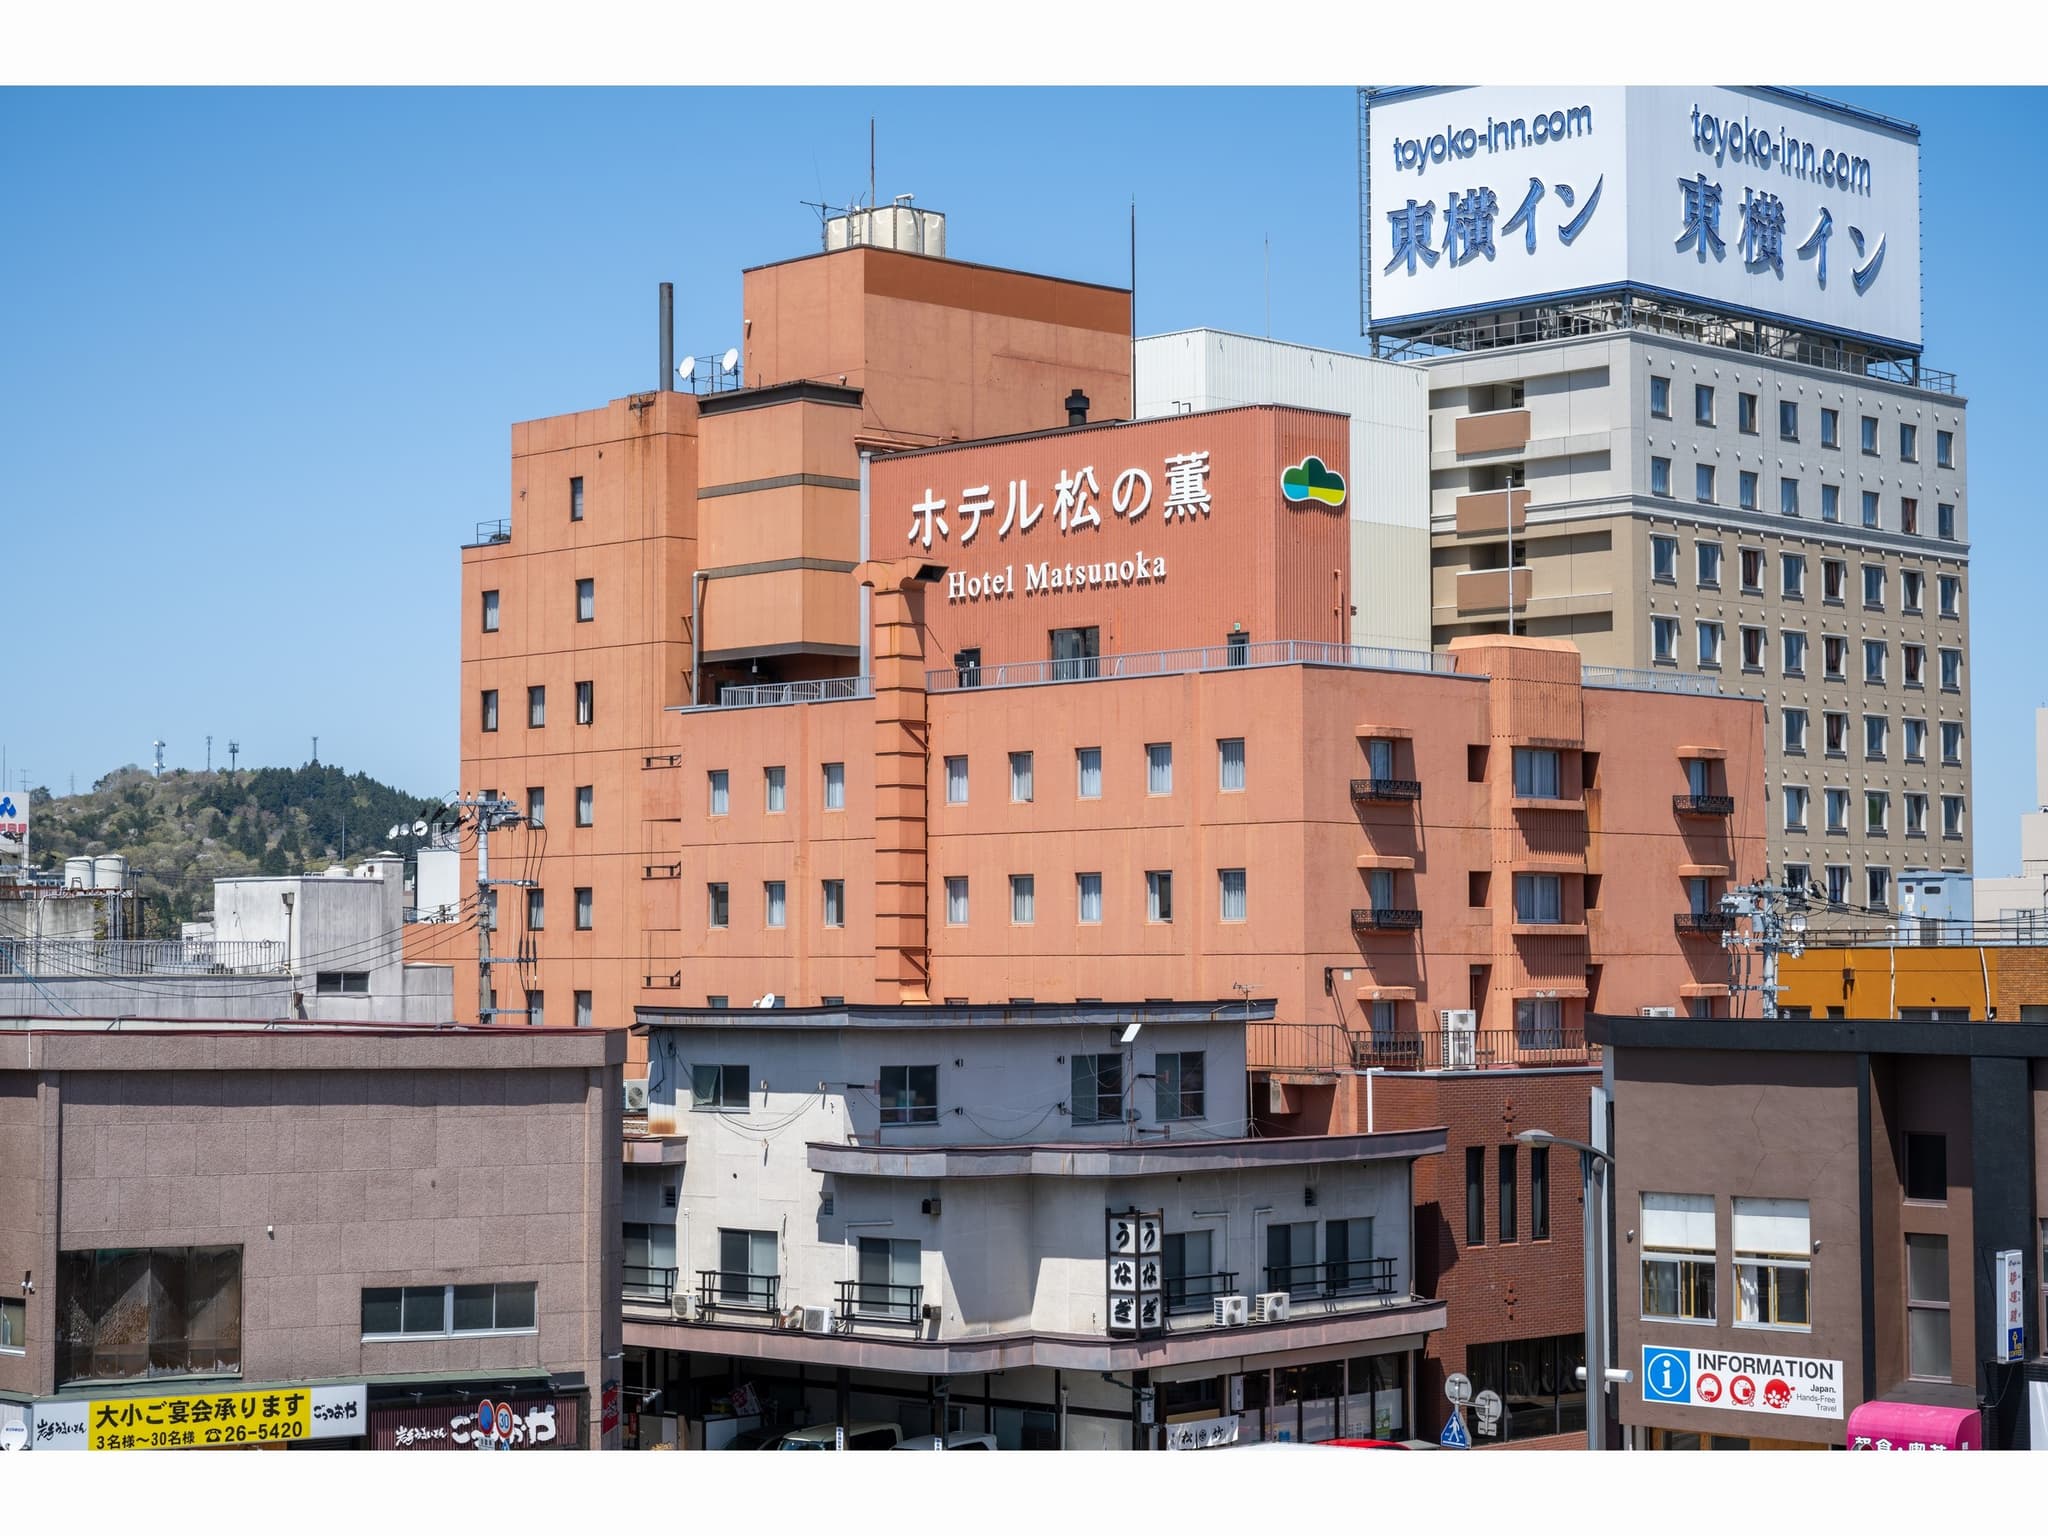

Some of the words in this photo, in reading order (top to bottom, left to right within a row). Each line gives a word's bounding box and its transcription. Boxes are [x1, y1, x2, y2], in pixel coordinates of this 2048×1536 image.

[1393, 105, 1592, 175] toyoko-inn.com
[1690, 103, 1871, 194] toyoko-inn.com
[1384, 173, 1603, 276] 東横イン
[1675, 173, 1886, 291] 東横イン
[908, 450, 1212, 549] ホテル松の薫
[948, 565, 1014, 599] Hotel
[1025, 551, 1167, 592] Matsunoka
[1696, 1353, 1833, 1380] INFORMATION
[1796, 1393, 1836, 1404] Hands-Free
[1810, 1384, 1836, 1394] Japan.
[96, 1393, 304, 1428] 大小ご宴会承ります
[499, 1413, 509, 1429] 30
[1816, 1403, 1837, 1412] Travel
[225, 1421, 302, 1442] 26-5420
